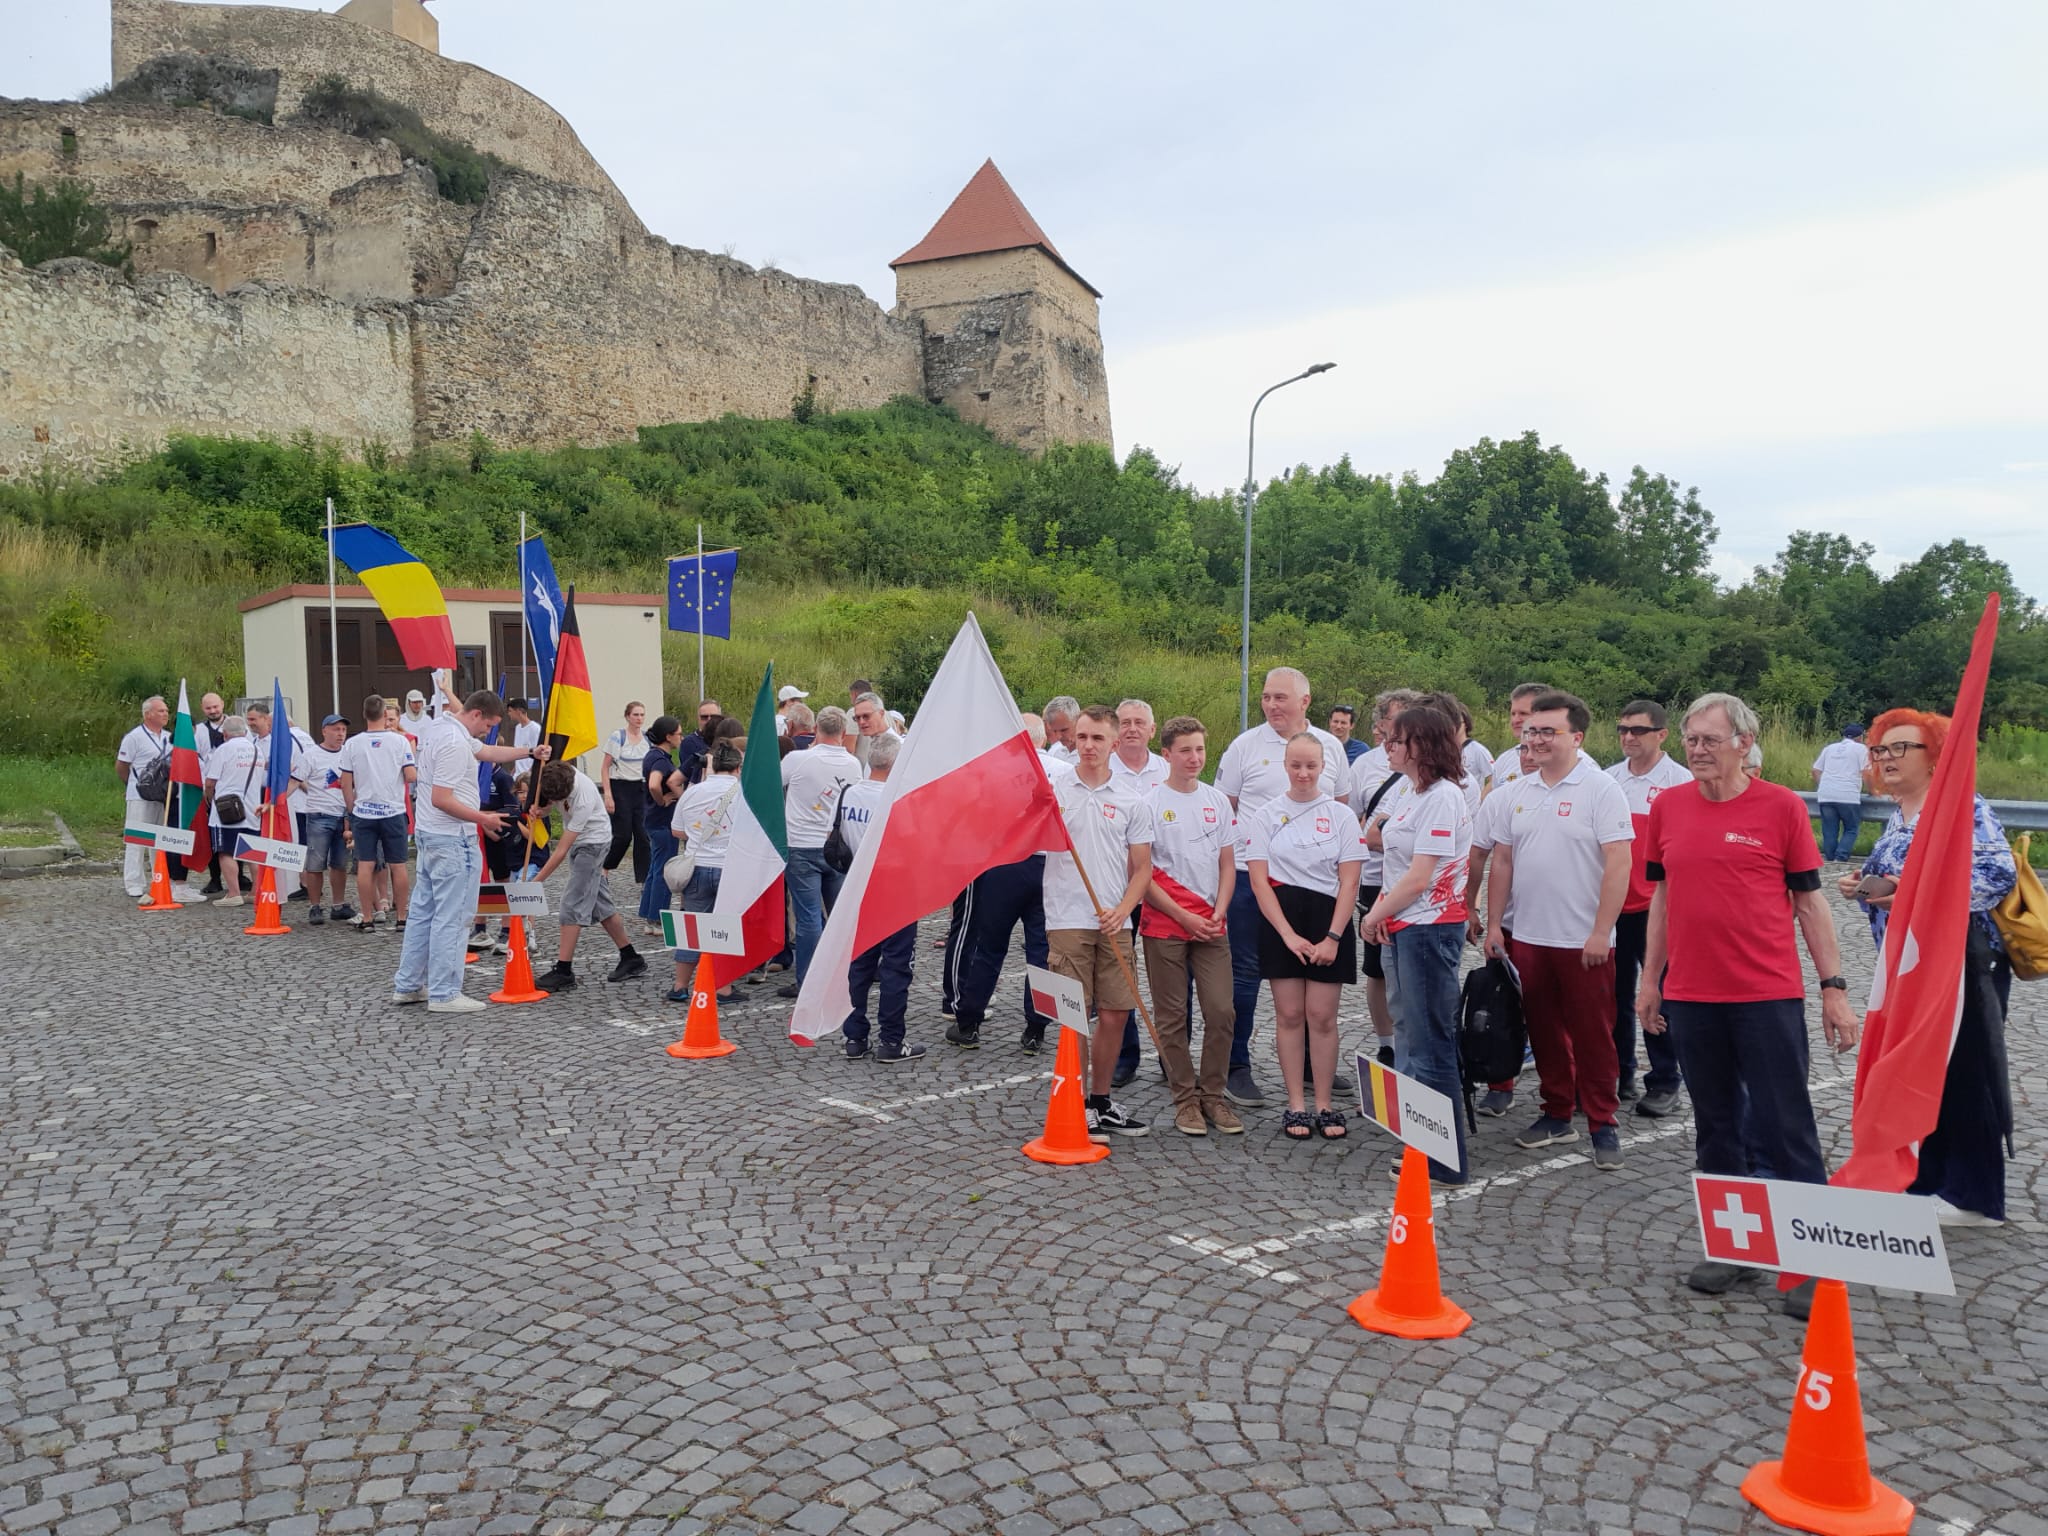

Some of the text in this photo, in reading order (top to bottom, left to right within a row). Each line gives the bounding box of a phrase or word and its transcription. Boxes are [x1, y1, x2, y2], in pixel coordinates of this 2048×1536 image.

[841, 806, 874, 823] TALI
[161, 835, 190, 846] Bulgaria
[278, 846, 299, 857] Czech
[272, 853, 302, 866] Republic
[261, 891, 276, 904] 70
[508, 894, 543, 904] Germany
[711, 929, 729, 942] Italy
[1061, 993, 1081, 1013] Poland
[1405, 1102, 1449, 1140] Romania
[1791, 1218, 1936, 1258] Switzerland
